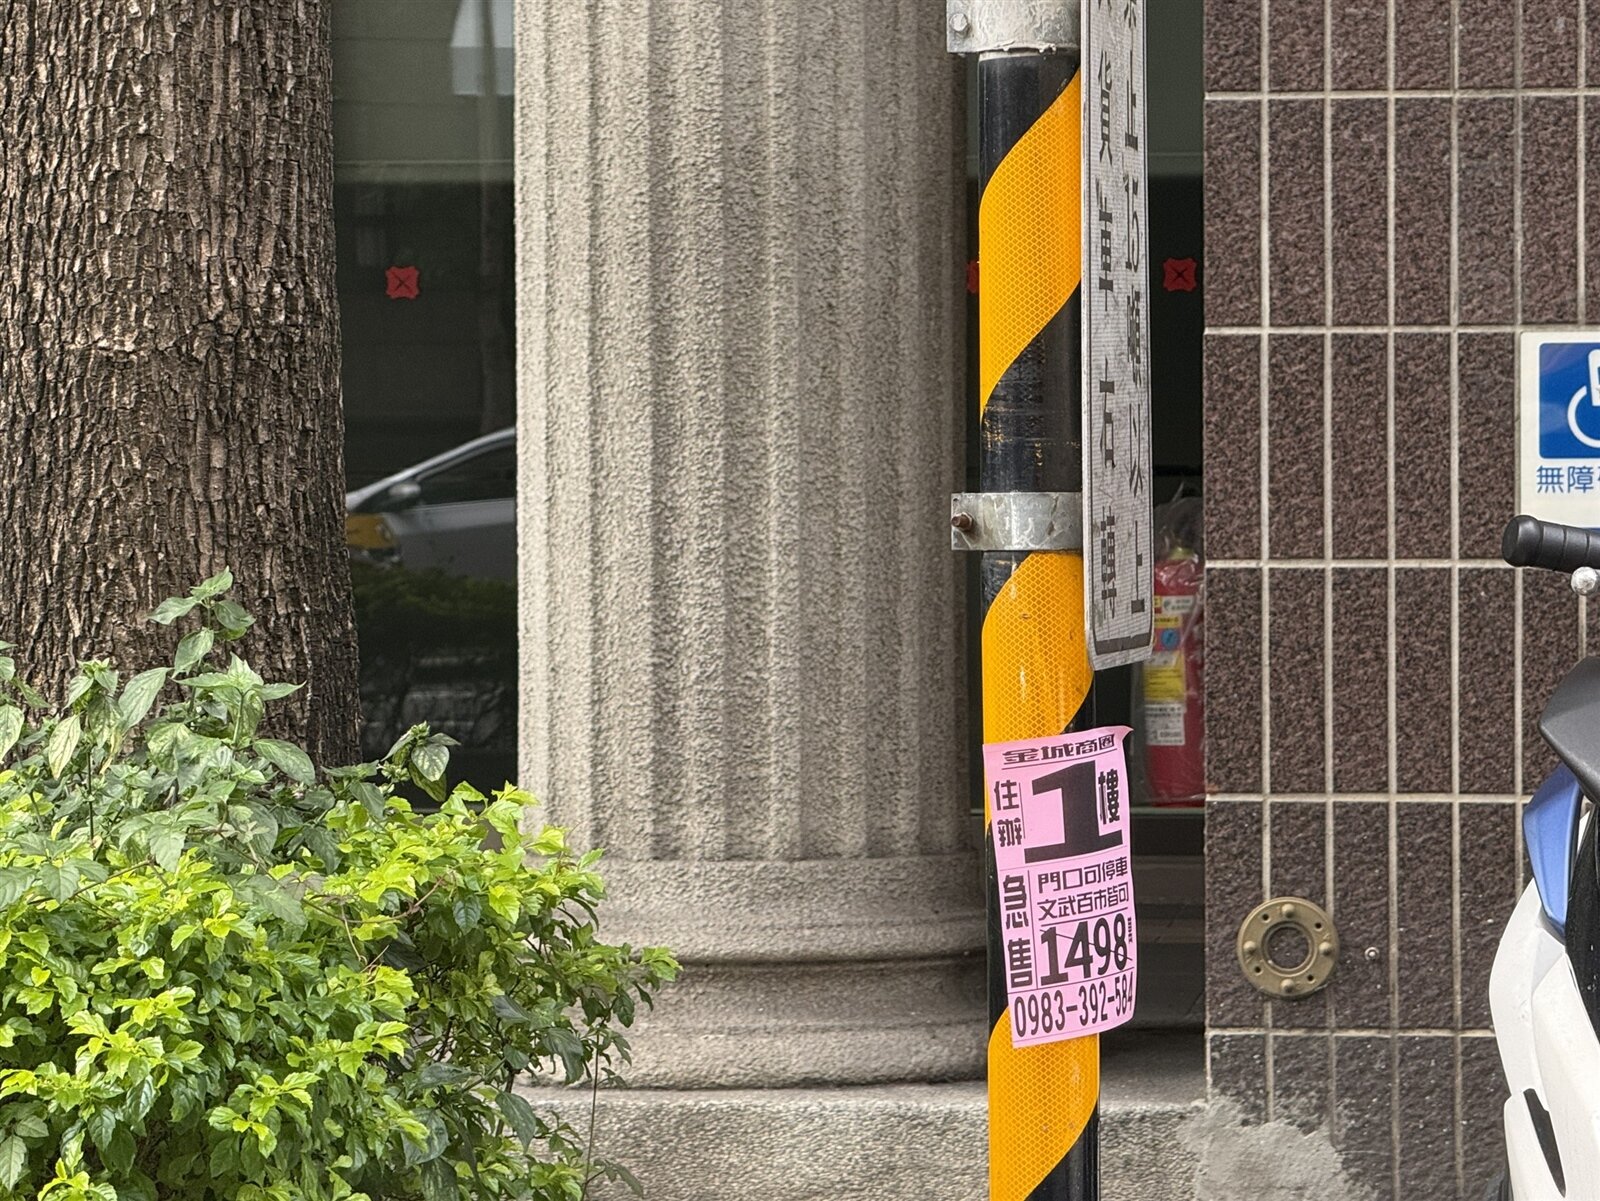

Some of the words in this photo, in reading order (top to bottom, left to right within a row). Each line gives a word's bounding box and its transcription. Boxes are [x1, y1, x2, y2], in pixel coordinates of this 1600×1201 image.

[1097, 0, 1117, 619] 貨車右轉
[1536, 464, 1600, 494] 無障
[1002, 734, 1115, 765] 金城商圈
[1037, 856, 1128, 894] 門口可停車
[1002, 874, 1033, 989] 急售
[1014, 971, 1134, 1038] 0983-392-584
